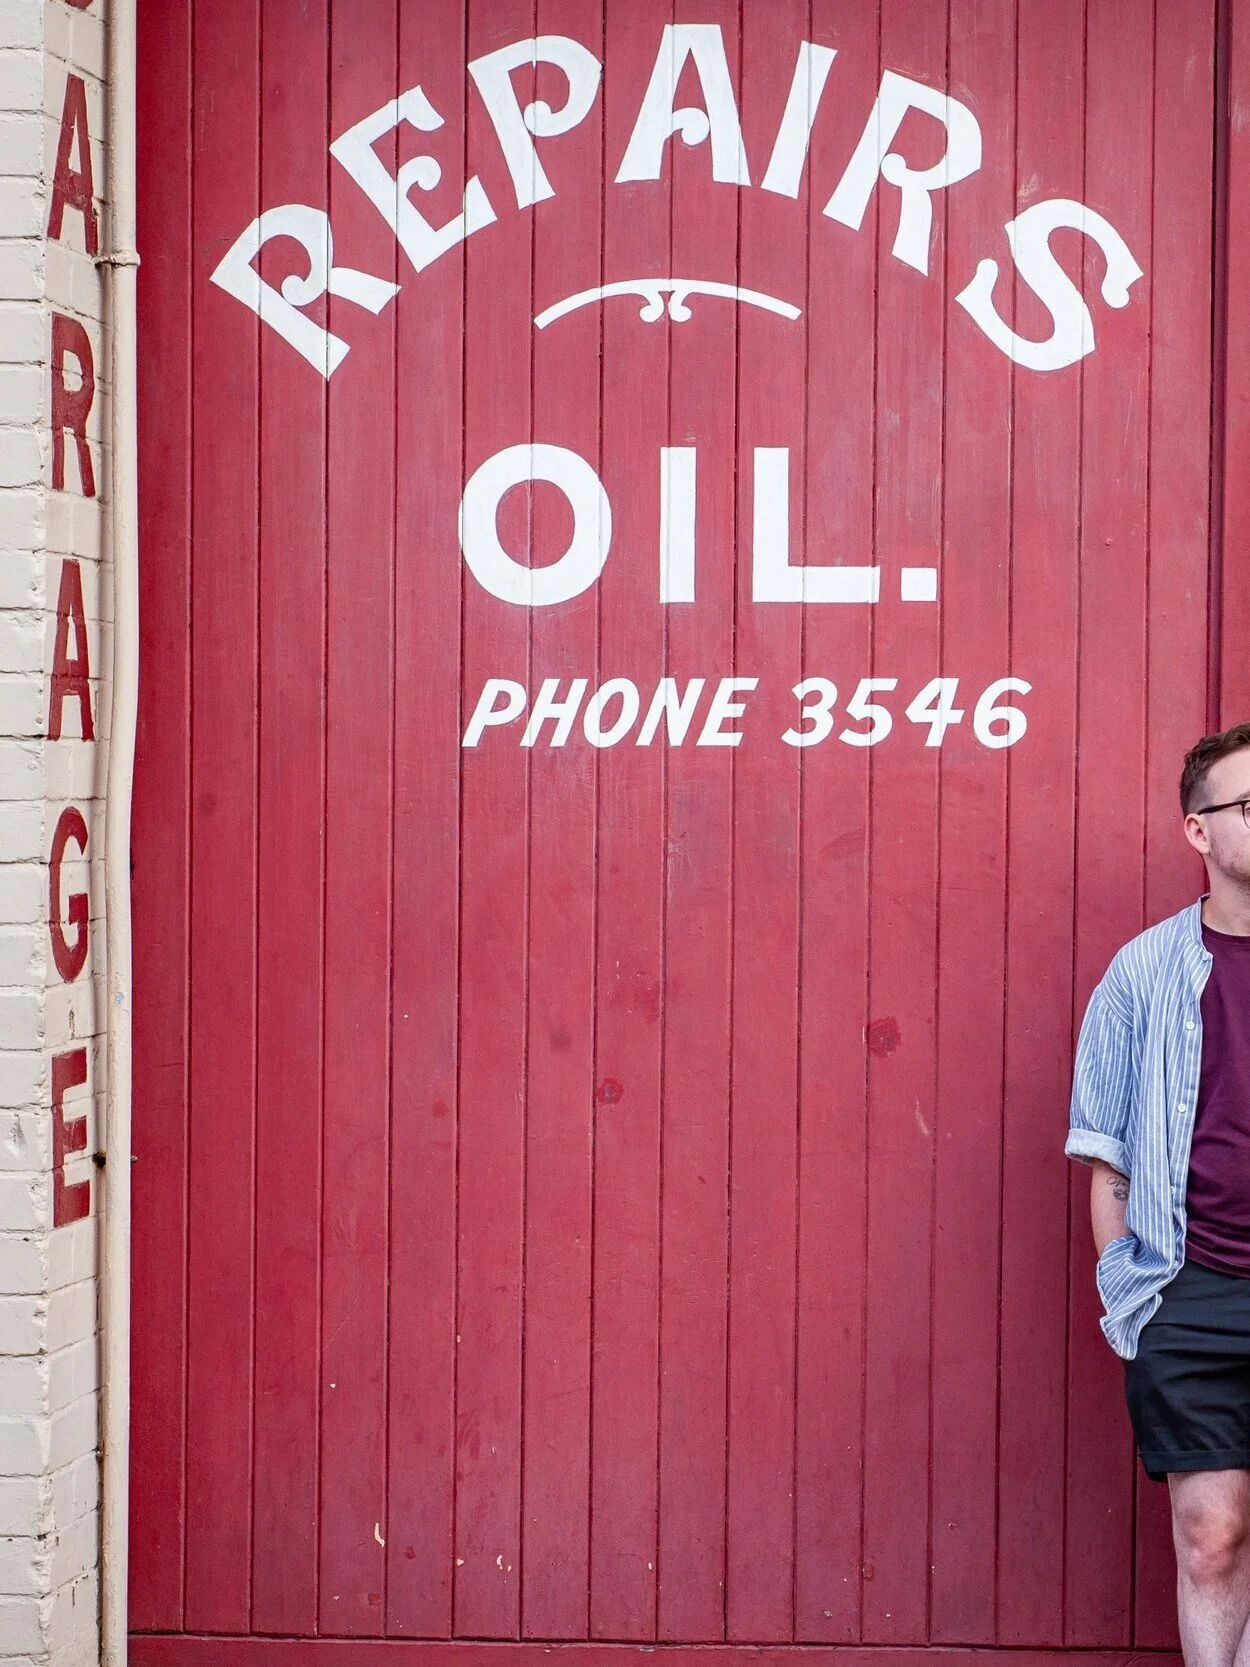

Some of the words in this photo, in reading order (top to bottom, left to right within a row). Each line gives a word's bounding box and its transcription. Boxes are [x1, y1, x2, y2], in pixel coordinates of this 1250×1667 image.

[209, 23, 1146, 374] REPAIRS
[47, 0, 98, 1228] ARAGE
[457, 443, 939, 607] OIL.
[461, 677, 761, 749] PHONE
[780, 677, 1034, 750] 3546
